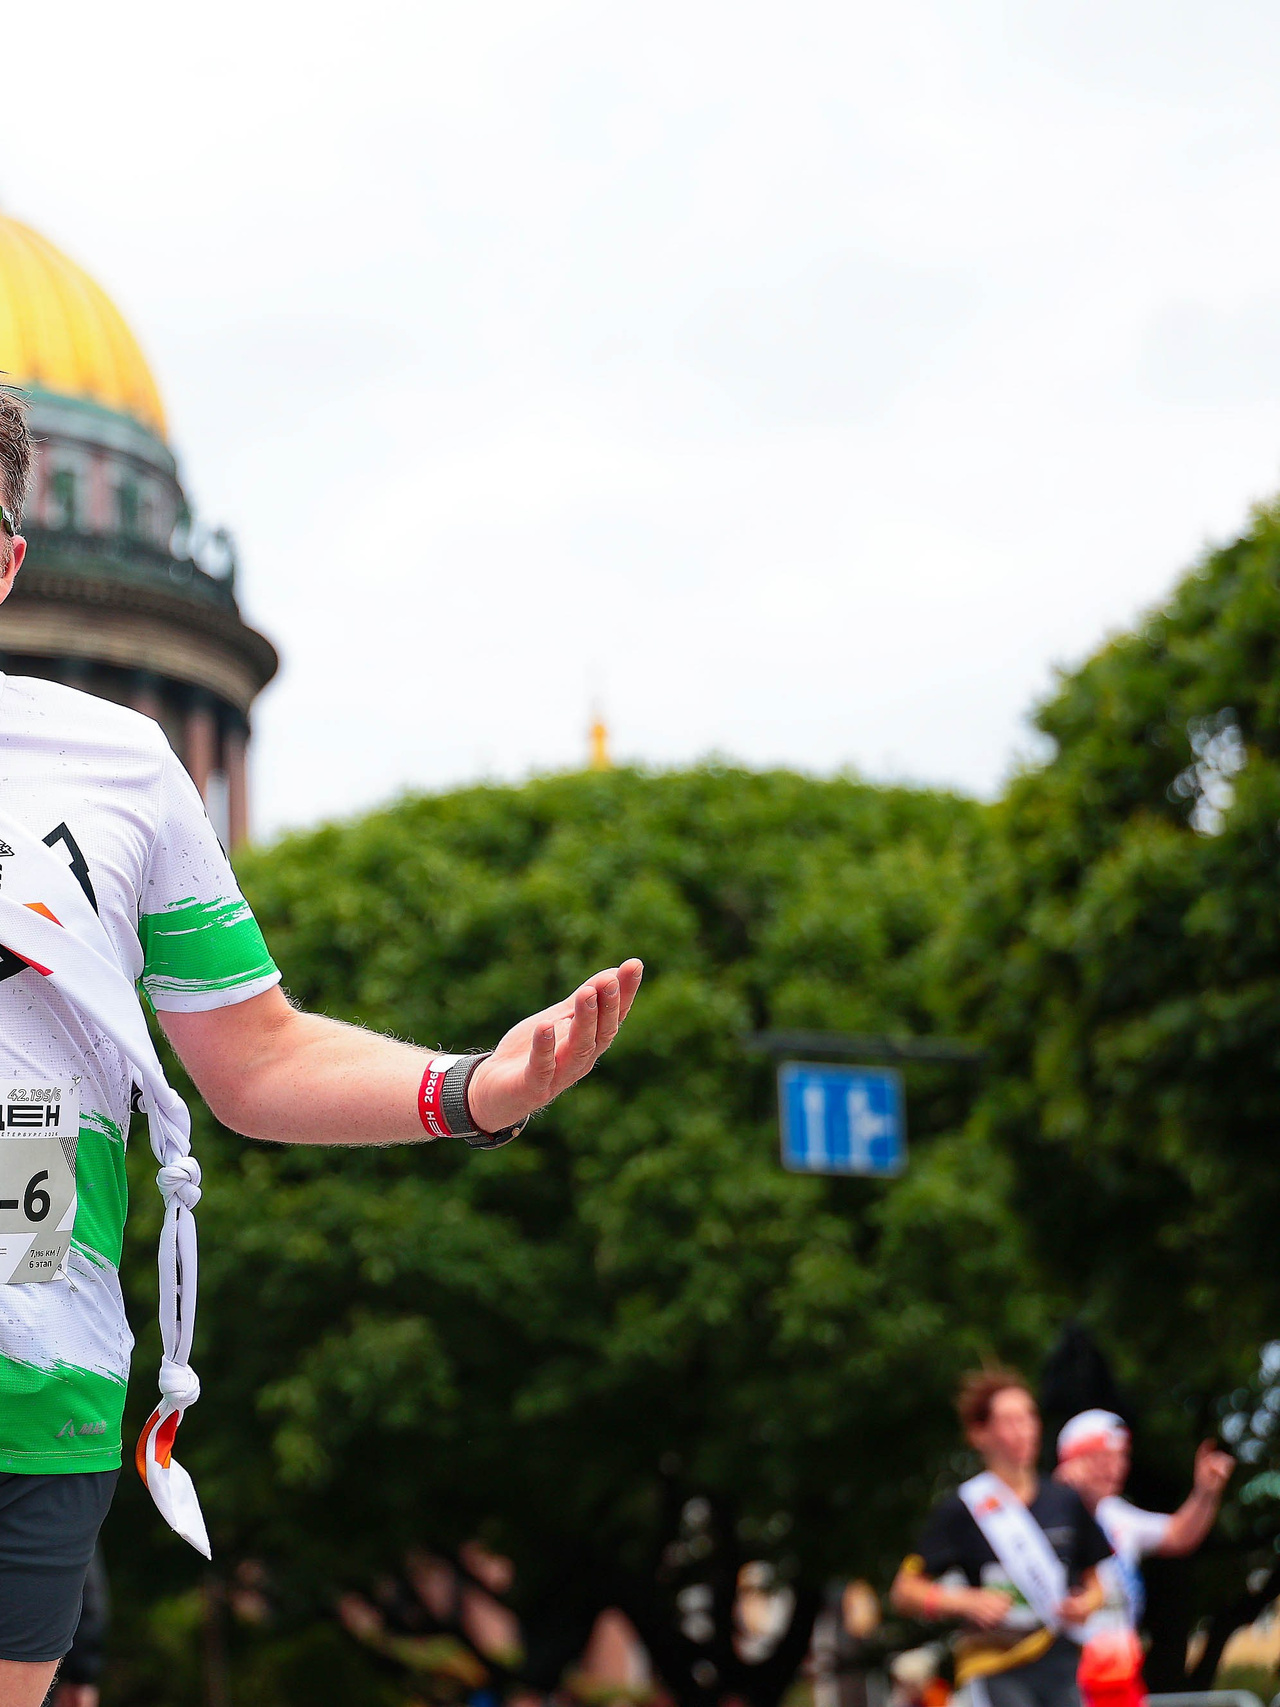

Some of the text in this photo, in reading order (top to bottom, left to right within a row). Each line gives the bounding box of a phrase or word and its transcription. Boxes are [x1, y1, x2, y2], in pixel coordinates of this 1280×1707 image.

[7, 1087, 62, 1103] 42.195/6
[424, 1072, 439, 1104] 2026
[29, 1260, 52, 1269] 6 этап
